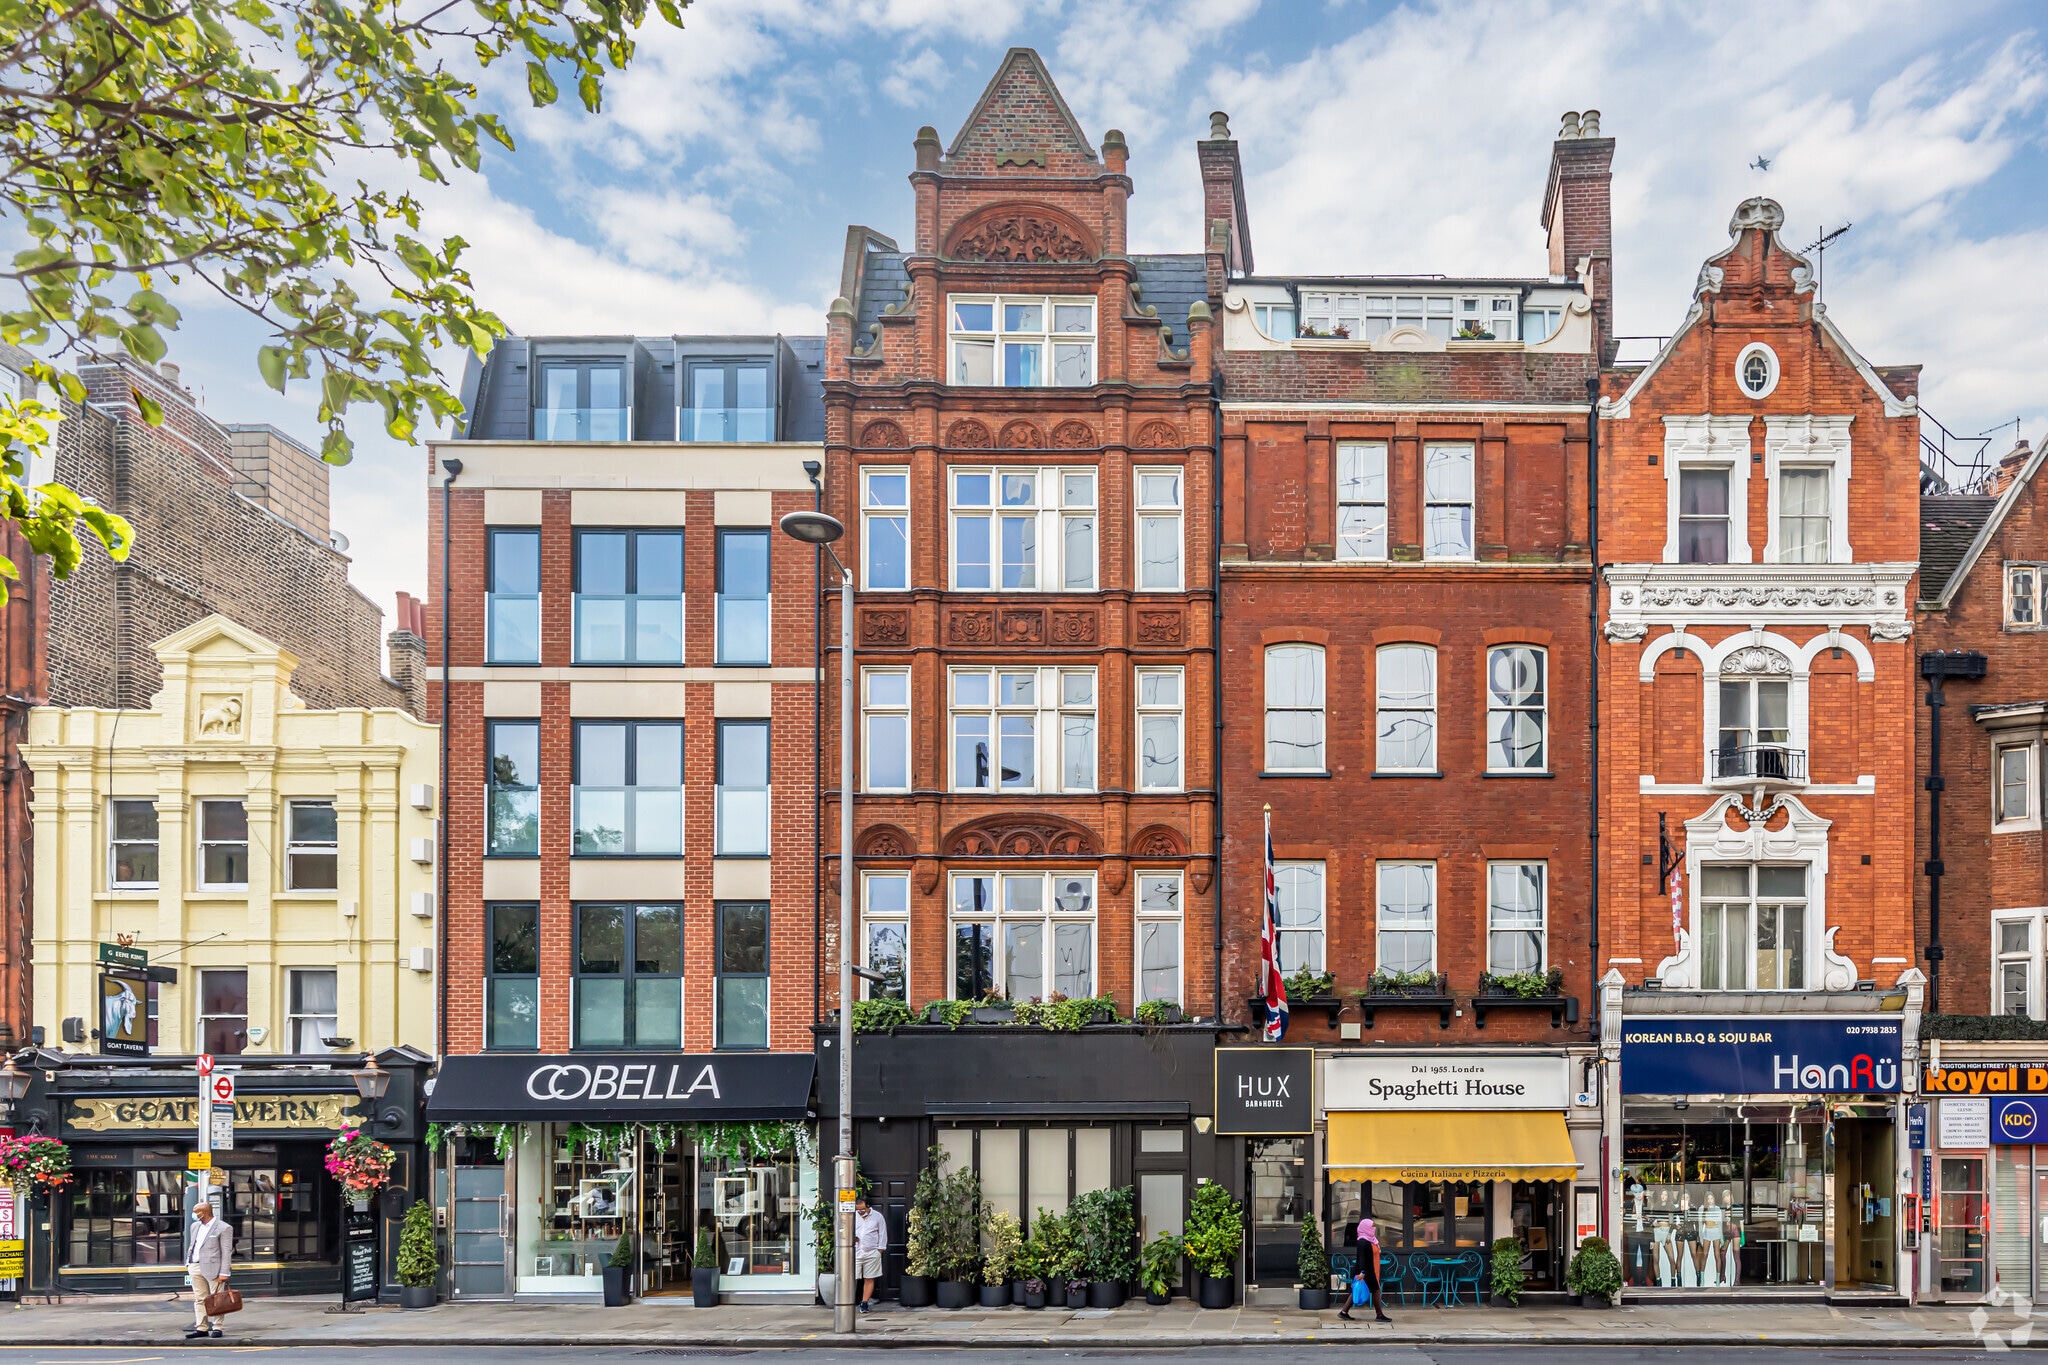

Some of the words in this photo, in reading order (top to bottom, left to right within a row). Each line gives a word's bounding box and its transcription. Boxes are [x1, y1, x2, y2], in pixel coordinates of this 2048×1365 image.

[108, 950, 129, 958] GEENE
[1626, 1034, 1673, 1043] KOREAN
[1675, 1033, 1705, 1044] B.B.Q
[1707, 1033, 1716, 1042] &
[1719, 1033, 1747, 1044] SOJU
[1750, 1033, 1772, 1042] BAR
[199, 1056, 210, 1070] N
[1774, 1054, 1896, 1089] HanRü
[526, 1064, 720, 1100] COBELLA
[1238, 1075, 1290, 1098] HUX
[1368, 1078, 1458, 1100] Spaghetti
[1465, 1080, 1525, 1096] House
[1926, 1068, 2017, 1094] Royal
[116, 1102, 198, 1122] GOAT
[233, 1100, 320, 1121] VERN
[2005, 1114, 2032, 1126] KDC
[1400, 1170, 1418, 1178] Cucina
